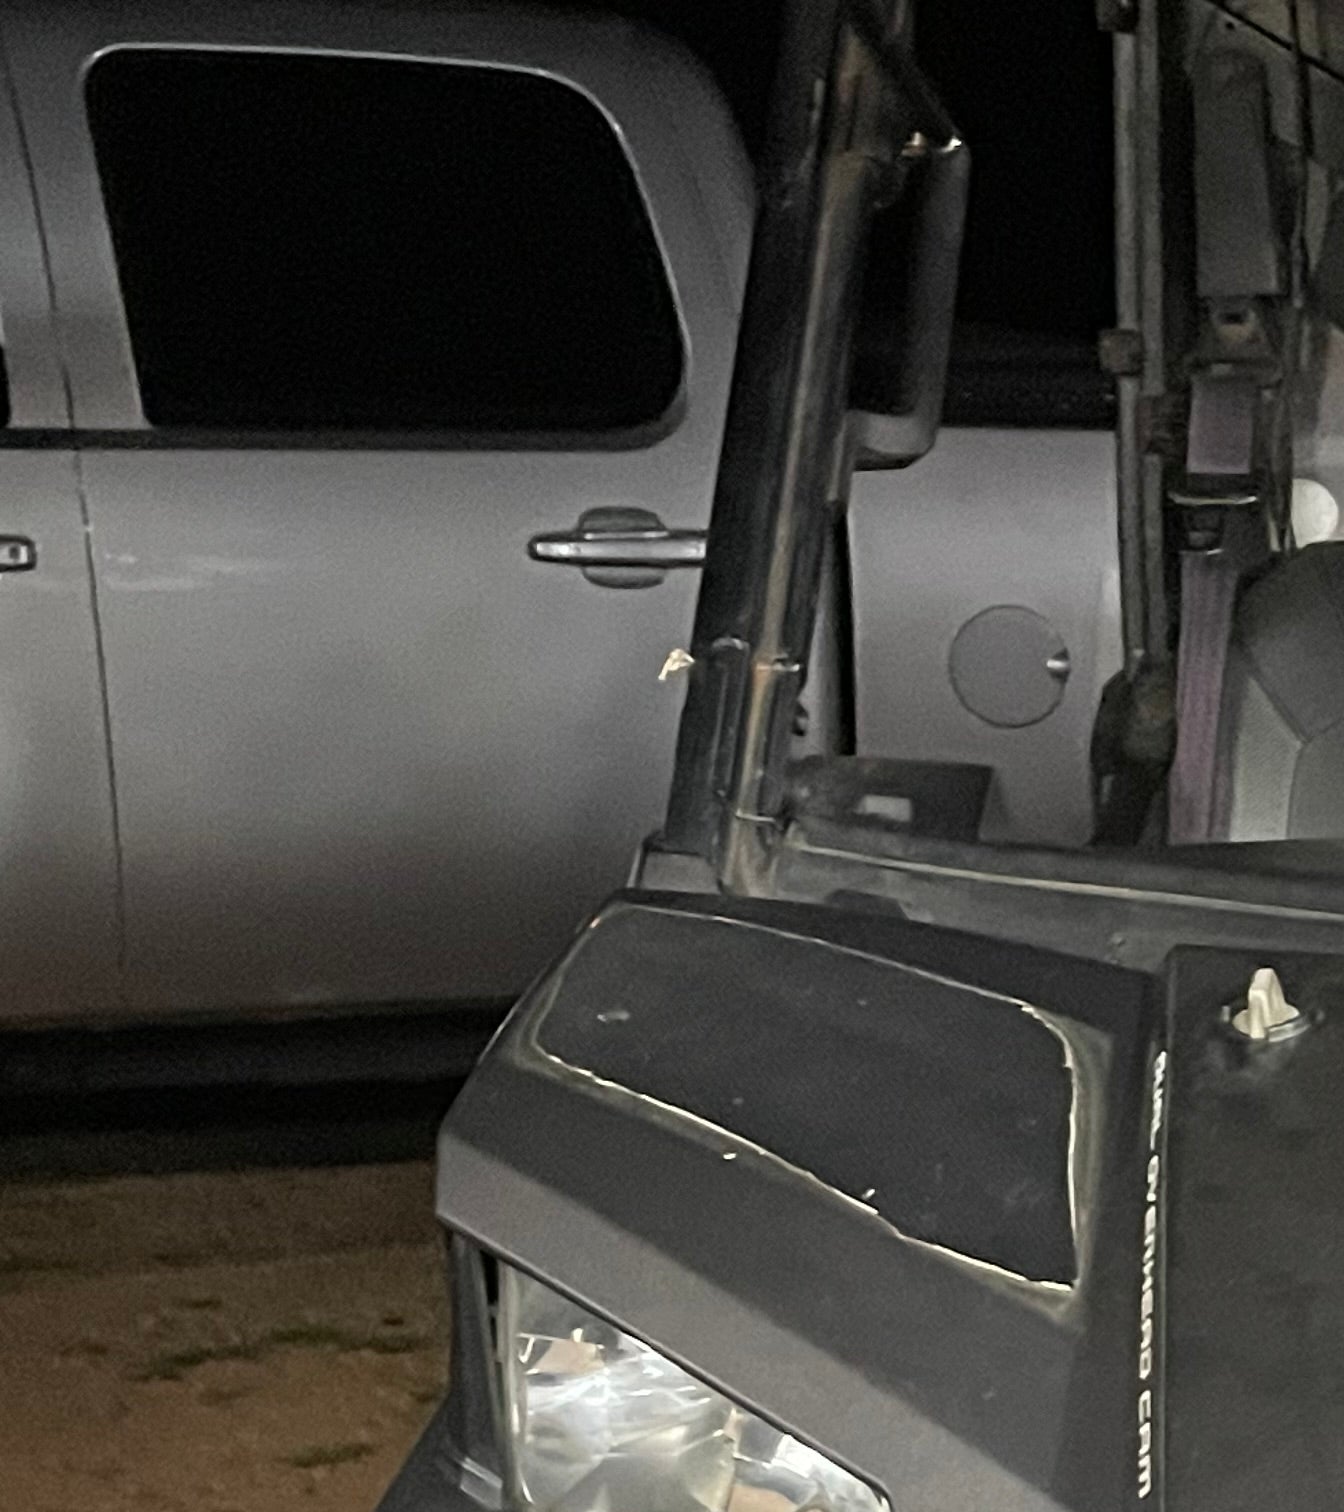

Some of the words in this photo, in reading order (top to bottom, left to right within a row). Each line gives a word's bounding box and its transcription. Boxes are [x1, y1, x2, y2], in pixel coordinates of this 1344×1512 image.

[1148, 1050, 1168, 1152] DUAL
[1138, 1153, 1160, 1380] OVERHEAD
[1136, 1388, 1153, 1499] CAM
